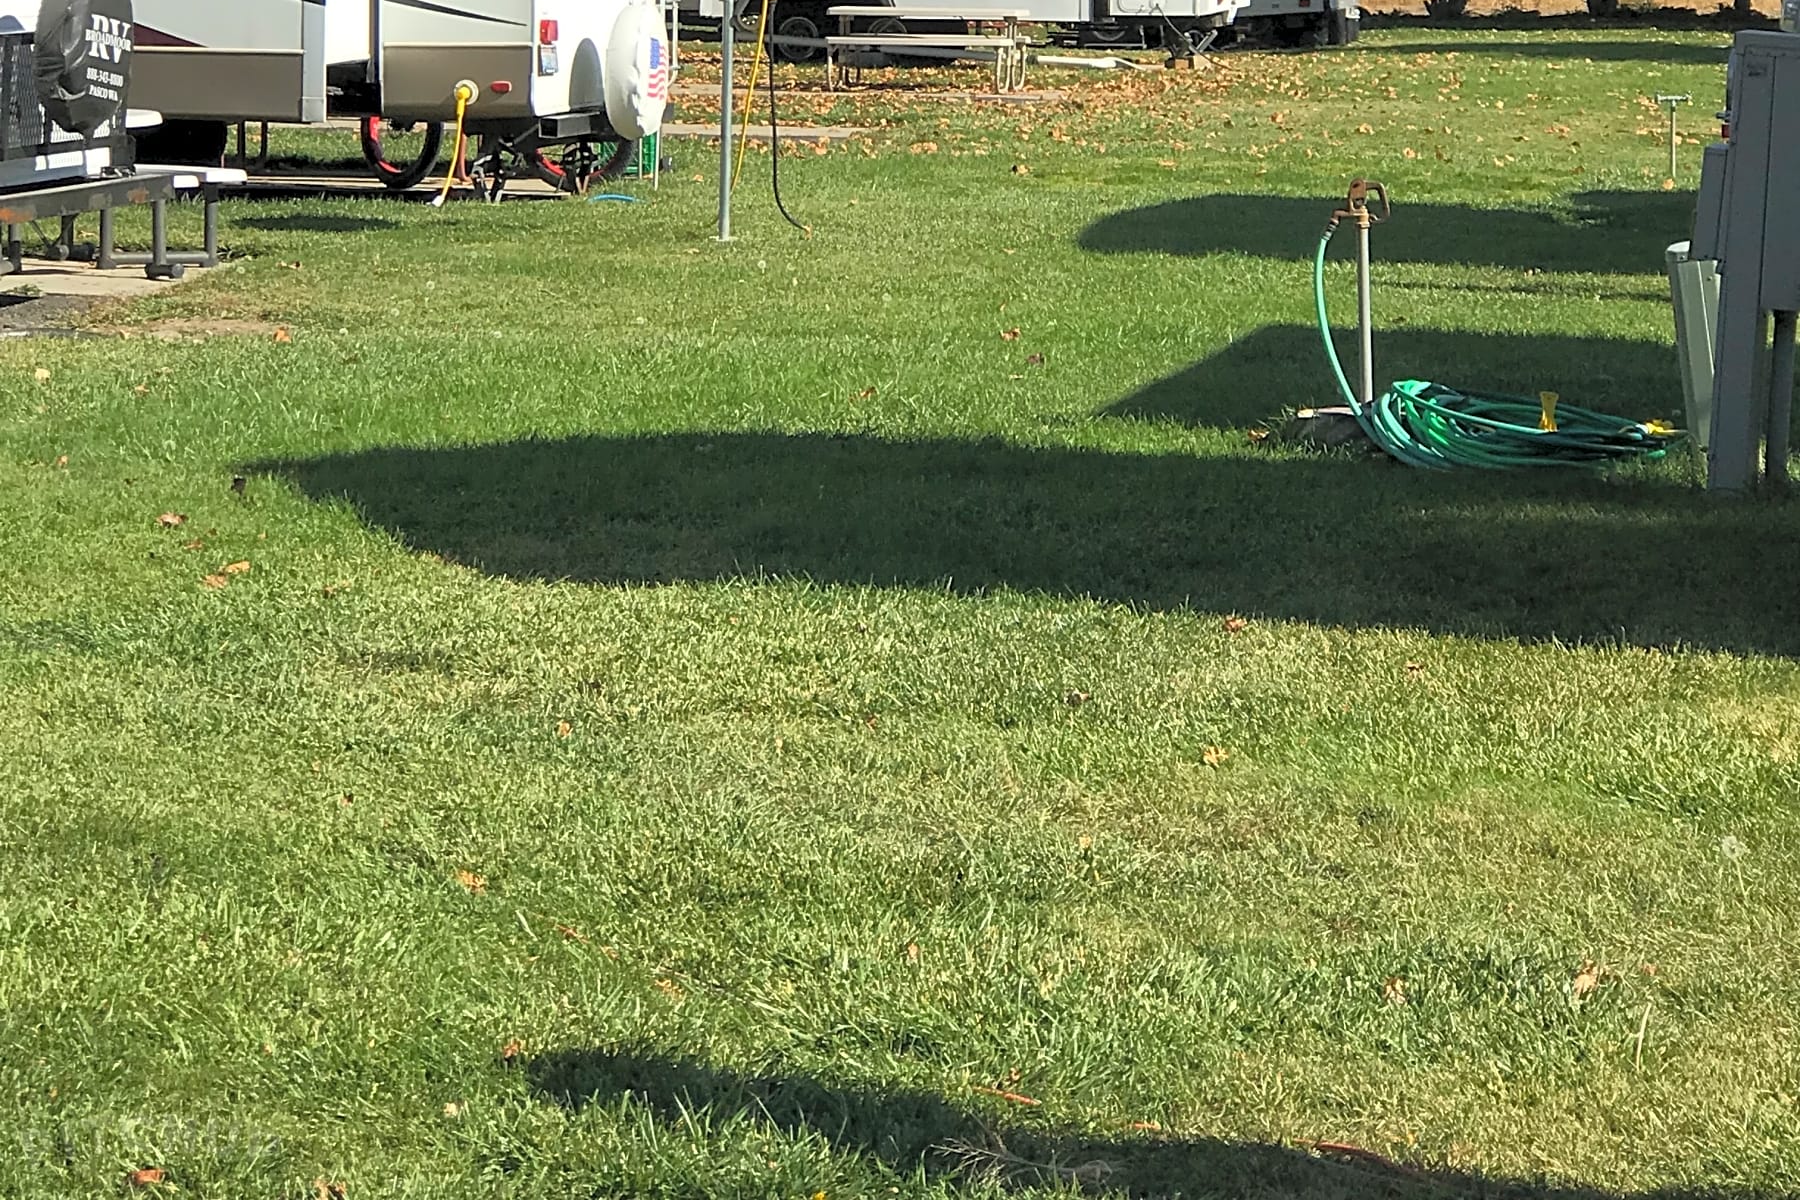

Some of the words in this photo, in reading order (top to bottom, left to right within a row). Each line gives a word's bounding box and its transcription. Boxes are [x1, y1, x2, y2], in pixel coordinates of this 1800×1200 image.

[85, 29, 132, 52] BROADMOOR
[88, 13, 131, 63] RV
[89, 84, 108, 100] PASCO
